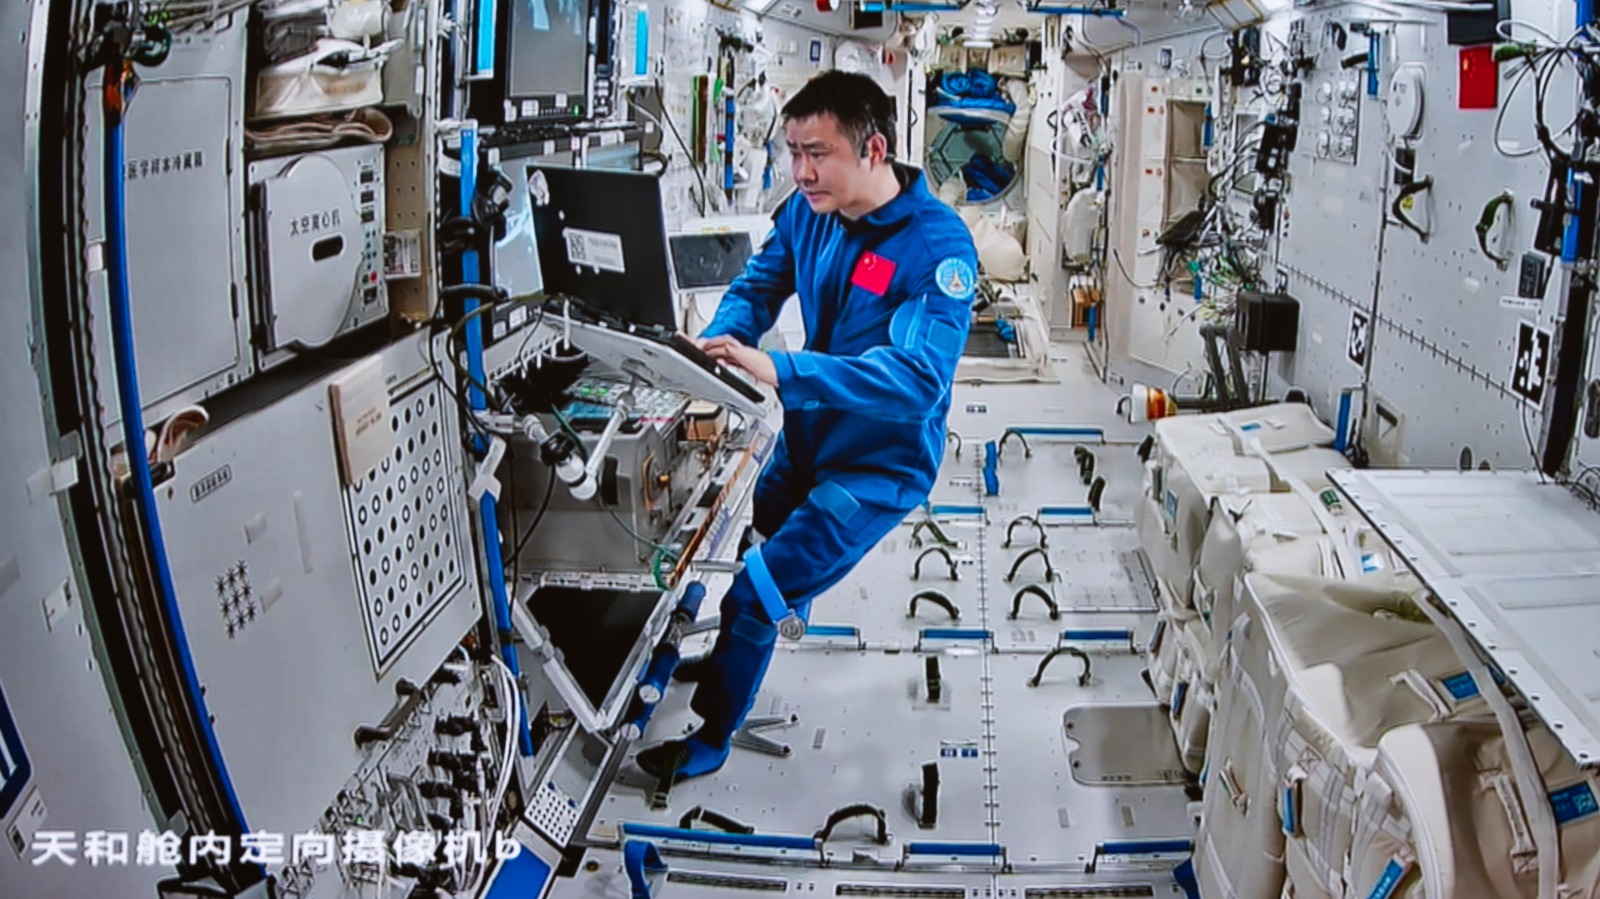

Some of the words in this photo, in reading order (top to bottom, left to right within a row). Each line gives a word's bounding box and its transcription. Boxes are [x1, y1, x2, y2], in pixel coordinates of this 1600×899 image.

[289, 208, 340, 237] 太空离心机
